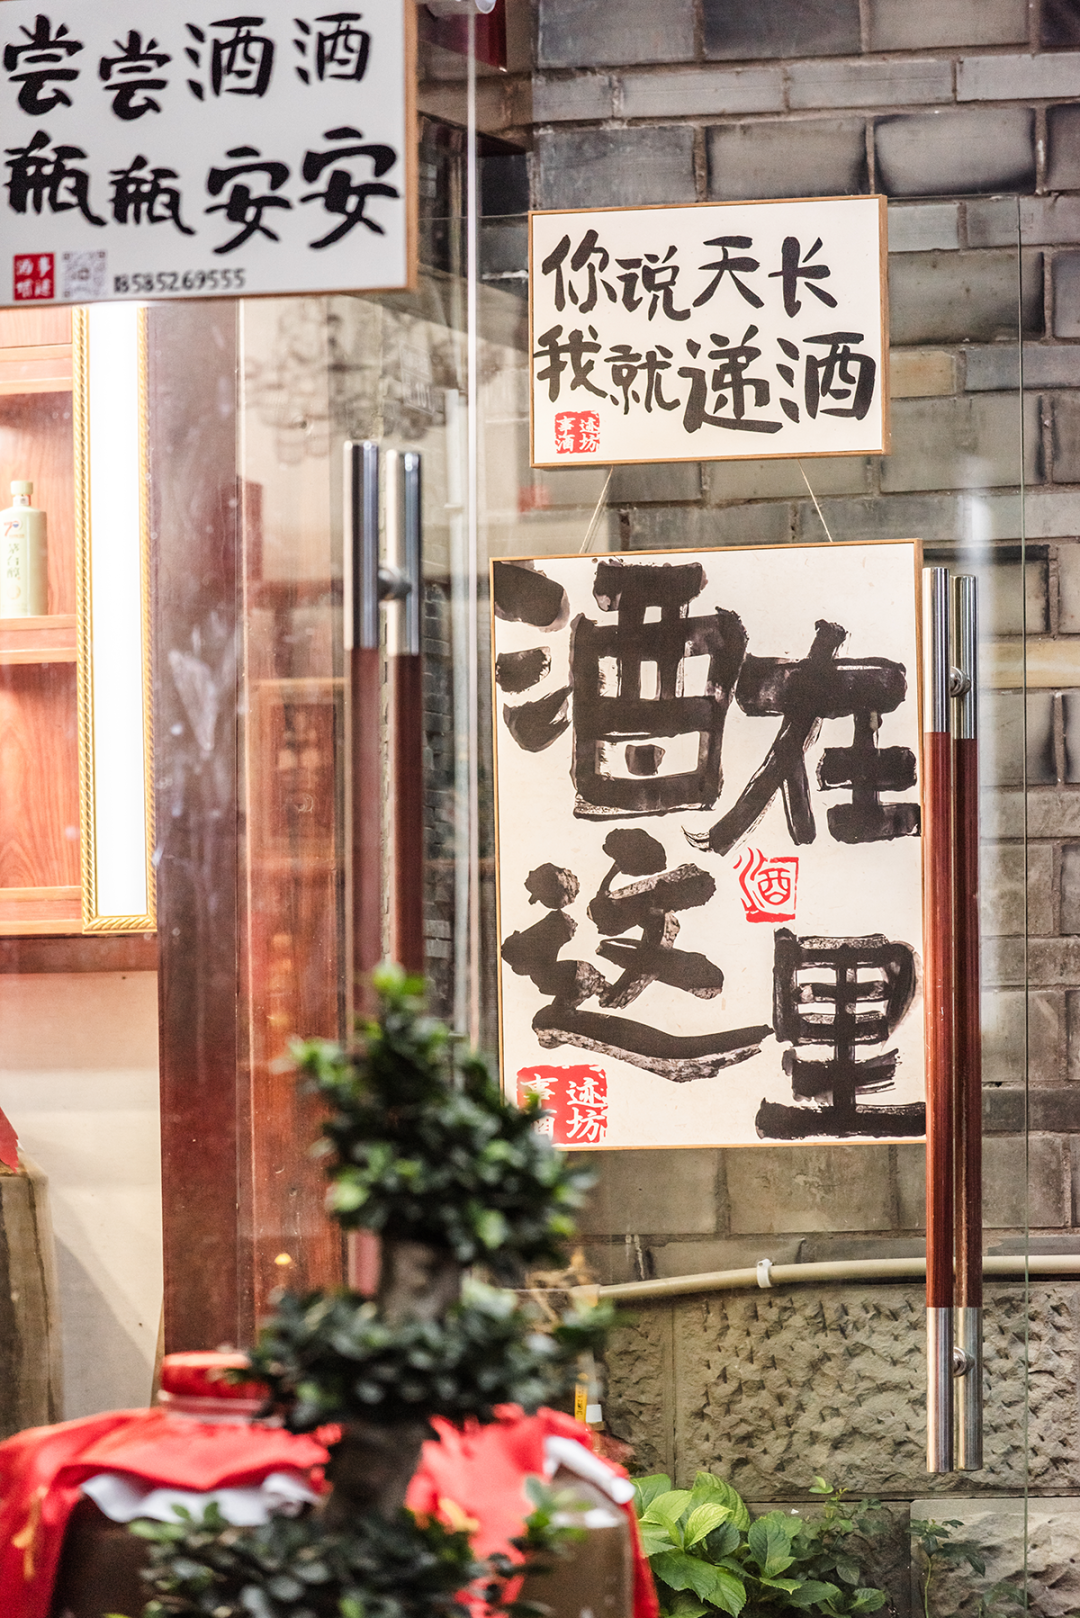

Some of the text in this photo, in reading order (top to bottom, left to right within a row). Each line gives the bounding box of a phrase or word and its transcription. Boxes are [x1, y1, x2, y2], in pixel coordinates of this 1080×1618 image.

[3, 13, 371, 121] 尝尝酒酒
[3, 126, 400, 255] 瓶瓶安安
[541, 228, 838, 322] 你说天长
[533, 324, 876, 434] 我就递酒
[494, 558, 921, 856] 酒在
[501, 828, 926, 1141] 这里
